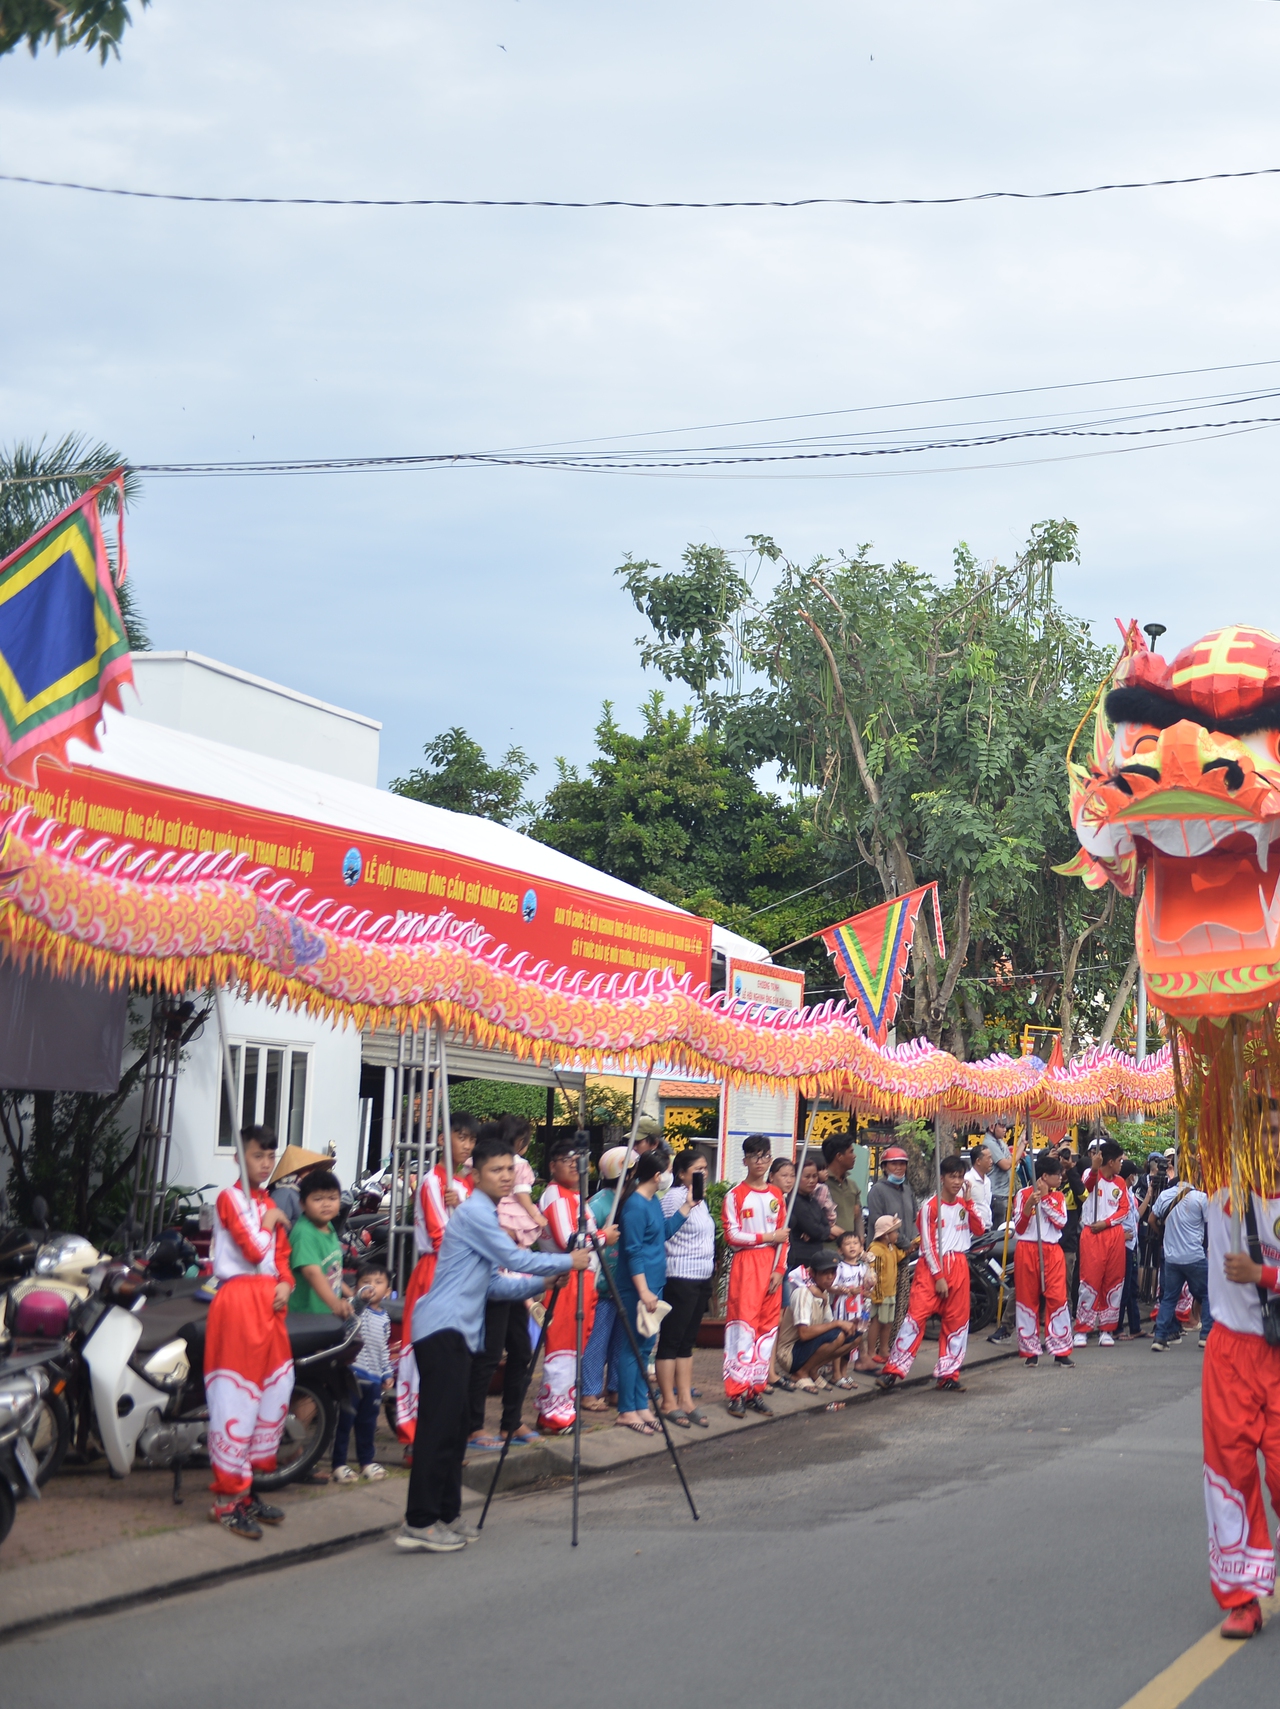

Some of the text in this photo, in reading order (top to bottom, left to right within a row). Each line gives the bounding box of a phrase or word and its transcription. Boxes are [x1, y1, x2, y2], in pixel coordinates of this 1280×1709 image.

[87, 804, 124, 835] NGHINH
[124, 807, 144, 839] ÔNG
[255, 841, 277, 866] THAM
[365, 855, 377, 882] LỄ
[377, 862, 393, 890] HỘI
[395, 868, 428, 893] NGHINH
[428, 871, 446, 896] ÔNG
[481, 886, 499, 909] NĂM
[500, 893, 518, 913] 2025
